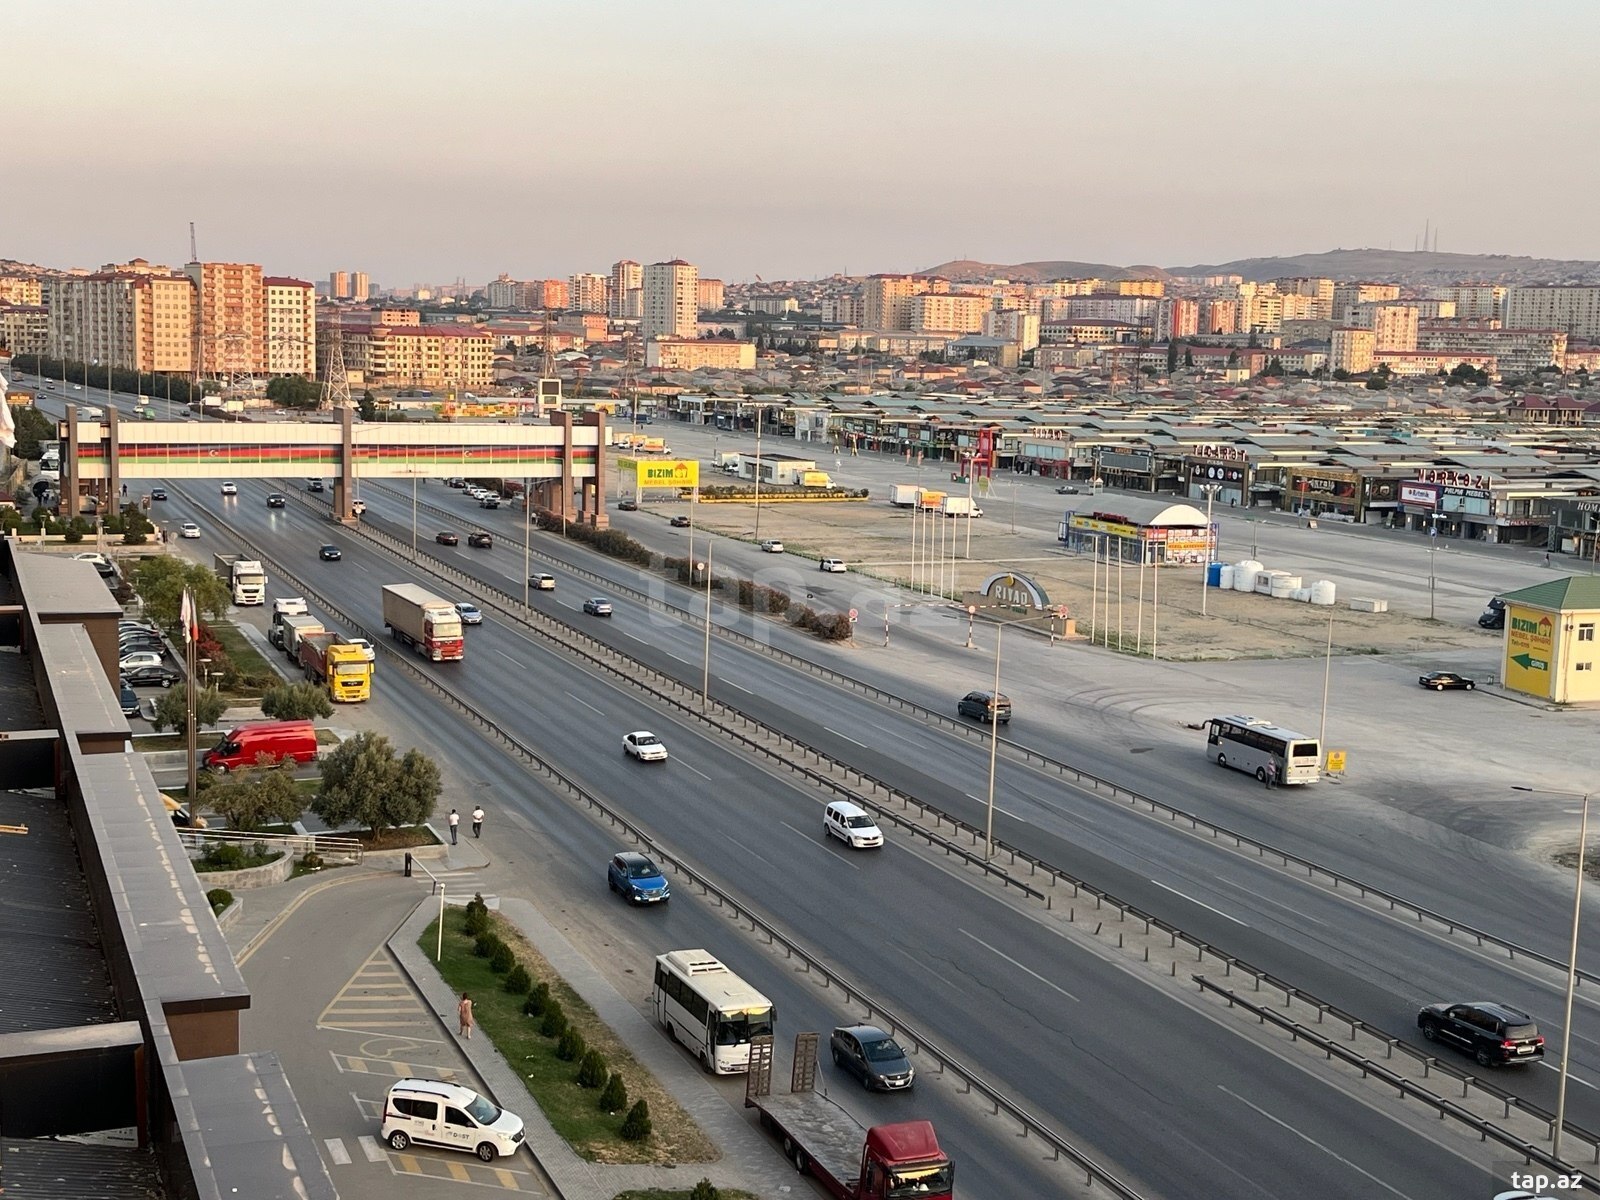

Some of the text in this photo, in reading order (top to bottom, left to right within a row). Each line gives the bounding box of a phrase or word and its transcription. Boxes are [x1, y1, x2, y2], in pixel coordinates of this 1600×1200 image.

[1444, 487, 1484, 498] PALMA MEBEL
[995, 585, 1027, 605] RIYAD
[1512, 618, 1537, 634] BIZIM
